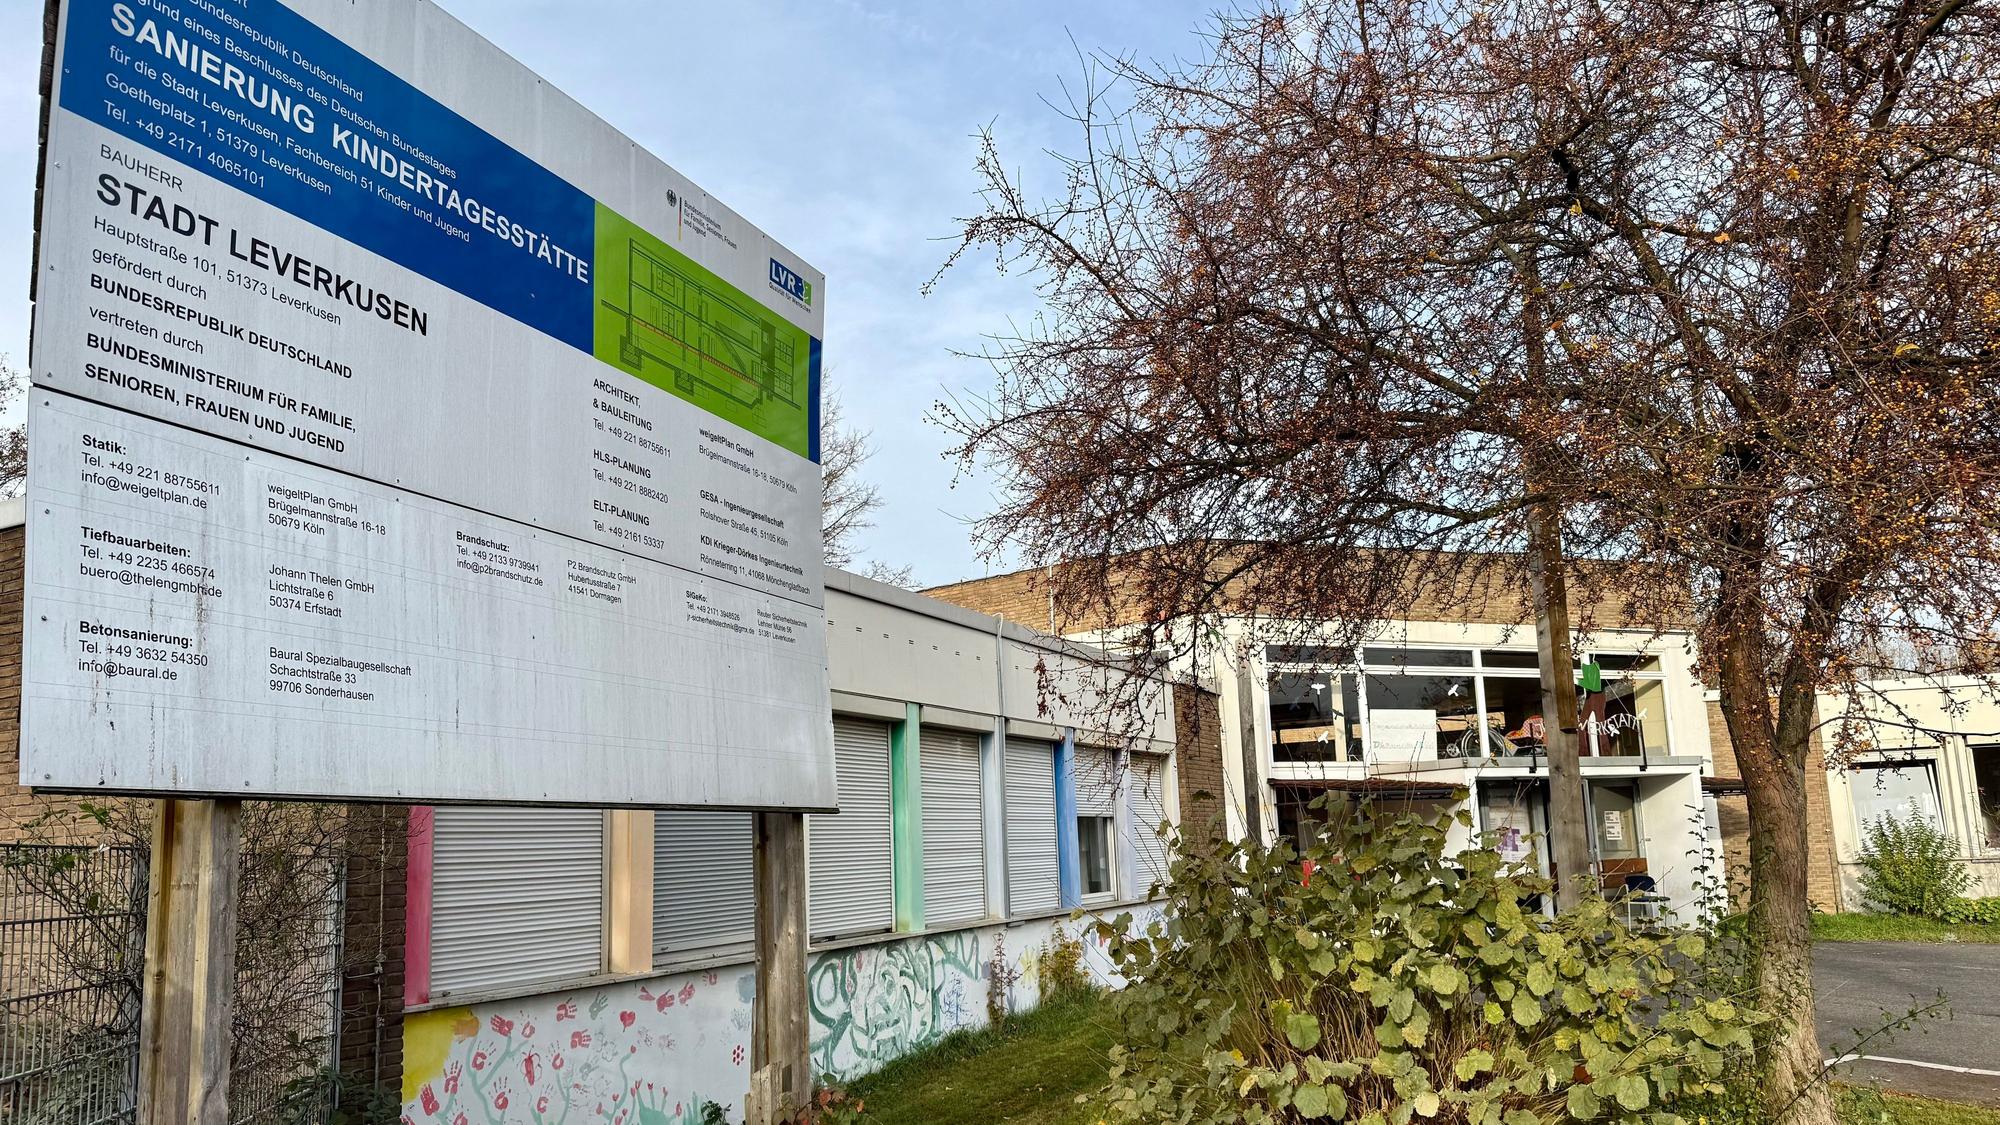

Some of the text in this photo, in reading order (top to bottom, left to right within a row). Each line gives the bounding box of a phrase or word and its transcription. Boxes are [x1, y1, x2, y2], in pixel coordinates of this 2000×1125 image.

[293, 50, 363, 101] Deutschland
[184, 17, 221, 45] eines
[225, 37, 303, 92] Beschlusses
[307, 86, 328, 106] des
[332, 98, 388, 140] Deutschen
[393, 134, 456, 179] Bundestages
[104, 100, 265, 188] Tel. +49 2171 4065101
[105, 72, 332, 195] Goetheplatz 1, 51379 Leverkusen
[110, 45, 470, 242] für die Stadt Leverkusen, Fachbereich 51 Kinder und Jugend
[111, 2, 588, 283] SANIERUNG KINDERTAGESSTÄTTE
[100, 143, 183, 192] BAUHERR
[97, 173, 427, 336] STADT LEVERKUSEN
[93, 247, 207, 300] gefördert durch
[94, 215, 341, 326] Hauptstraße 101, 51373 Leverkusen
[772, 262, 796, 293] LVR
[89, 306, 203, 354] vertreten durch
[90, 273, 352, 379] BUNDESREPUBLIK DEUTSCHLAND
[87, 332, 356, 433] BUNDESMINISTERIUM FÜR FAMILIE,
[593, 378, 641, 408] ARCHITEKT,
[85, 363, 344, 453] SENIOREN, FRAUEN UND JUGEND
[593, 398, 652, 431] & BAULEITUNG
[82, 434, 127, 456] Statik:
[593, 418, 671, 458] Tel. +49 221 88755611
[699, 427, 754, 458] weigeltPlan GmbH
[82, 452, 220, 496] Tel. +49 221 88755611
[594, 449, 651, 479] HLS-PLANUNG
[699, 445, 750, 474] Brügelmannstraße
[81, 470, 207, 509] info@weigeltplan.de
[268, 483, 358, 514] weigeltPlan GmbH
[593, 468, 669, 504] Tel. +49 221 8882420
[700, 489, 718, 505] GESA
[268, 498, 386, 535] Brügelmannstraße 16-18
[268, 514, 325, 536] 50679 Köln
[594, 500, 649, 526] ELT-PLANUNG
[81, 526, 191, 558] Tiefbauarbeiten:
[456, 530, 510, 552] Brandschutz:
[593, 519, 665, 550] Tel. +49 2161 53337
[80, 544, 215, 580] Tel. +49 2235 466574
[456, 545, 539, 573] Tel. +49 2133 9739941
[456, 558, 543, 586] info@p2brandschutz.de
[567, 560, 637, 584] P2 Brandschutz GmbH
[269, 563, 375, 594] Johann Thelen GmbH
[269, 579, 334, 601] Lichtstraße 6
[568, 572, 621, 592] Hubertusstraße 7
[269, 596, 342, 618] 50374 Erfstadt
[568, 585, 622, 604] 41541 Dormagen
[79, 620, 193, 648] Betonsanierung:
[79, 639, 208, 667] Tel. +49 3632 54350
[270, 647, 412, 676] Baural Spezialbaugesellschaft
[78, 659, 178, 681] info@baural.de
[270, 663, 357, 684] Schachtstraße 33
[270, 680, 374, 702] 99706 Sonderhausen
